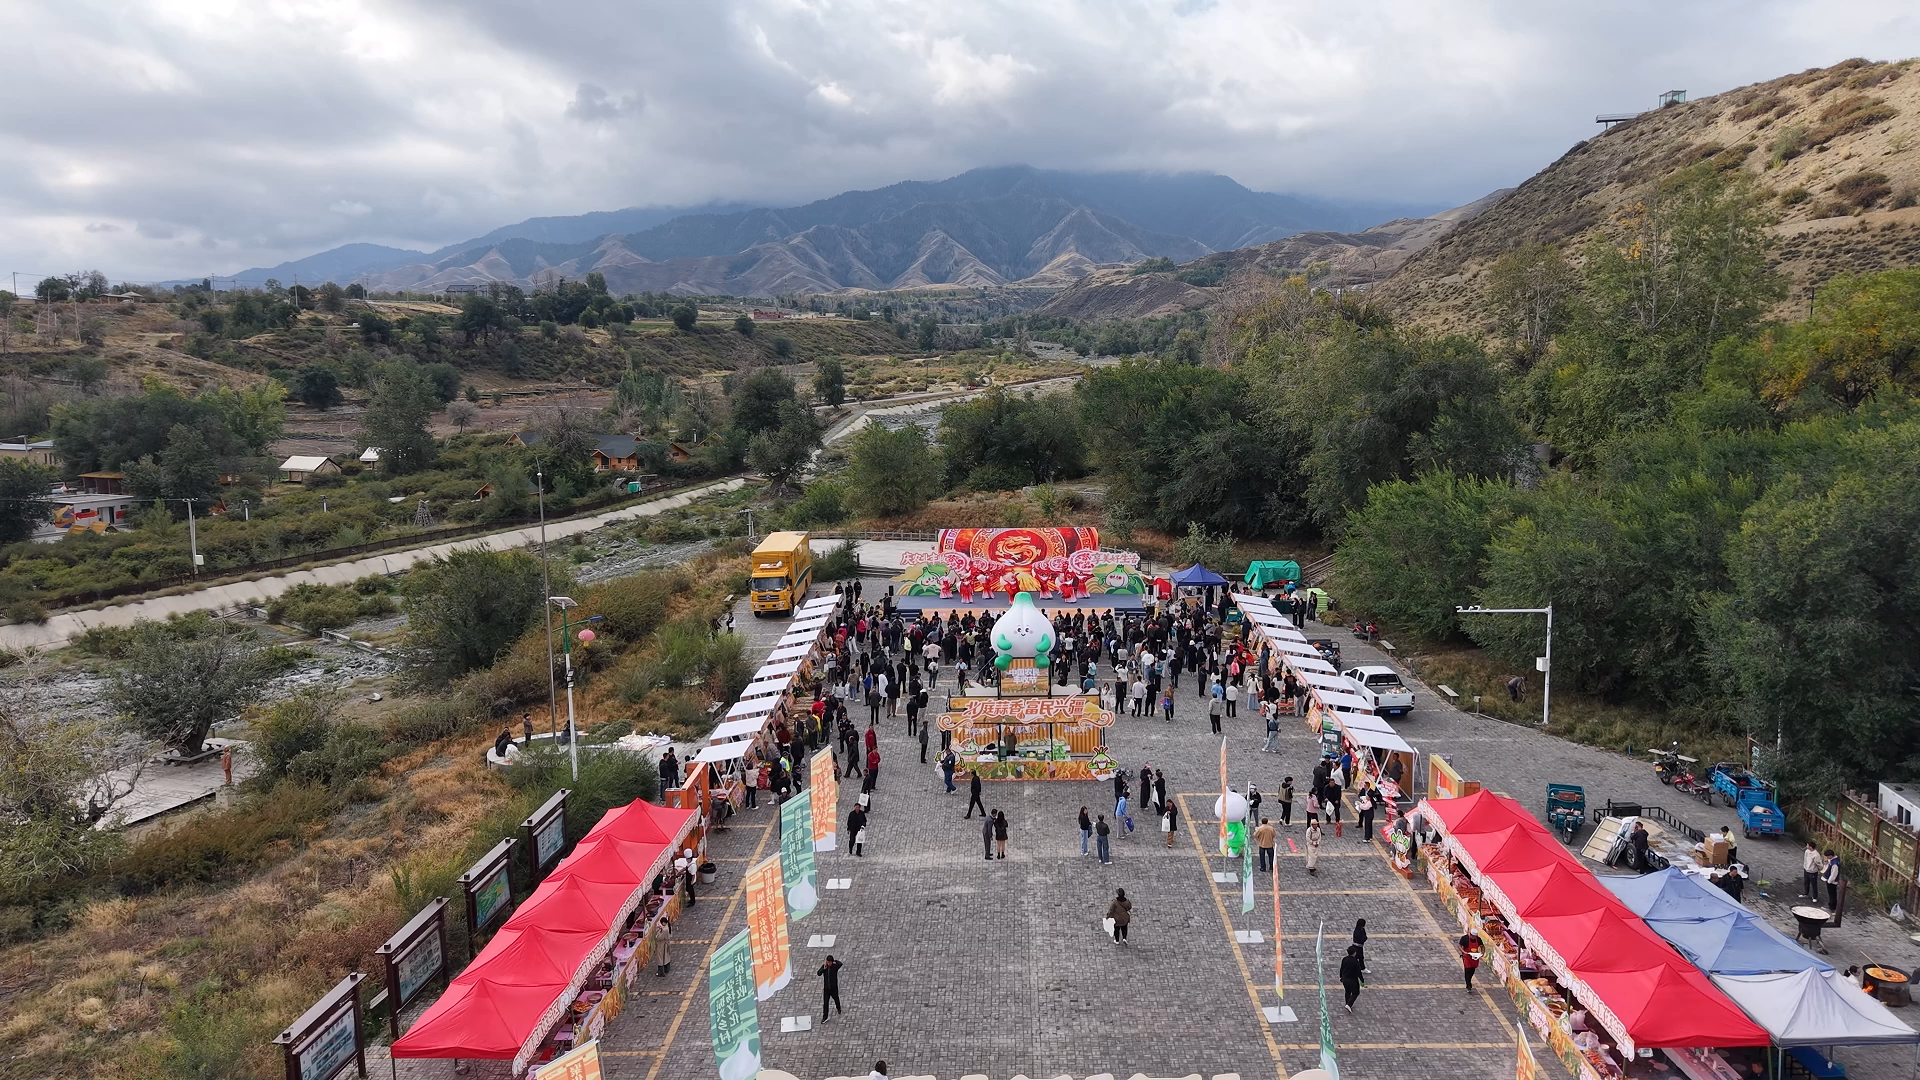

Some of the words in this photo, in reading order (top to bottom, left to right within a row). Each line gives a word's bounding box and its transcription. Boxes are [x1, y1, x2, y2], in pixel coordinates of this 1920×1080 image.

[963, 694, 1086, 718] 北庭蒜香富民兴疆
